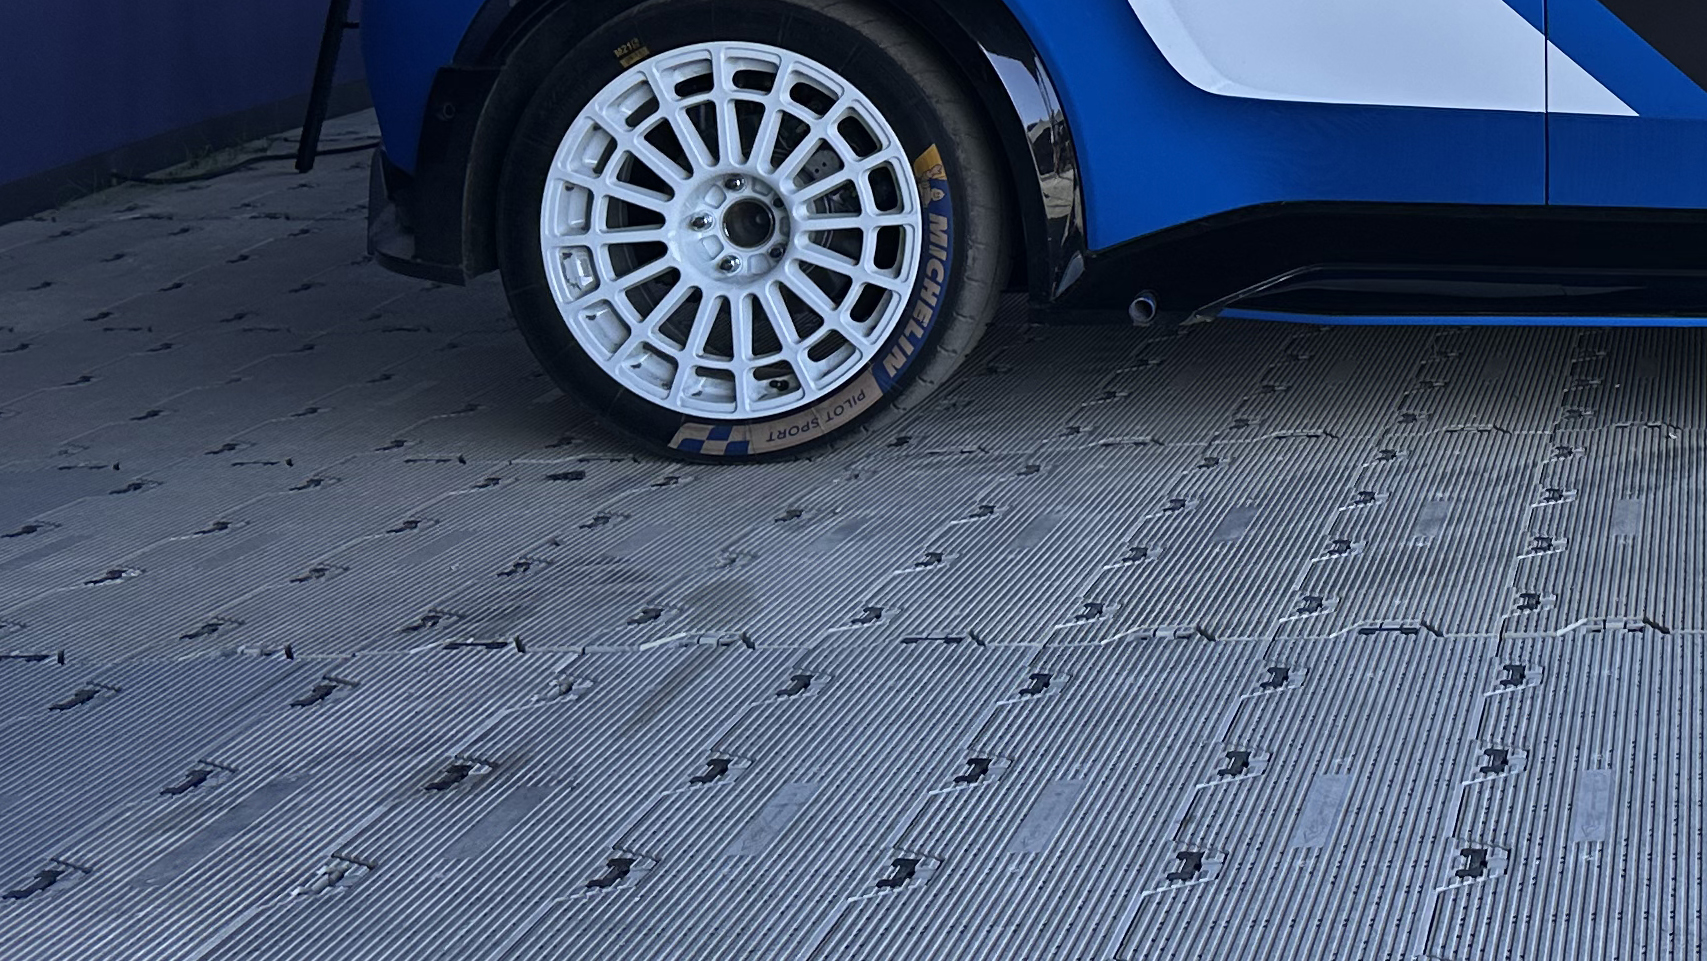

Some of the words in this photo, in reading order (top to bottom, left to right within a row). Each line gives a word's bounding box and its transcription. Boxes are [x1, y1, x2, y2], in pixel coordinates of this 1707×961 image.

[882, 212, 948, 378] MICHELIN
[825, 388, 866, 423] PILOT
[765, 417, 820, 442] SPORT
